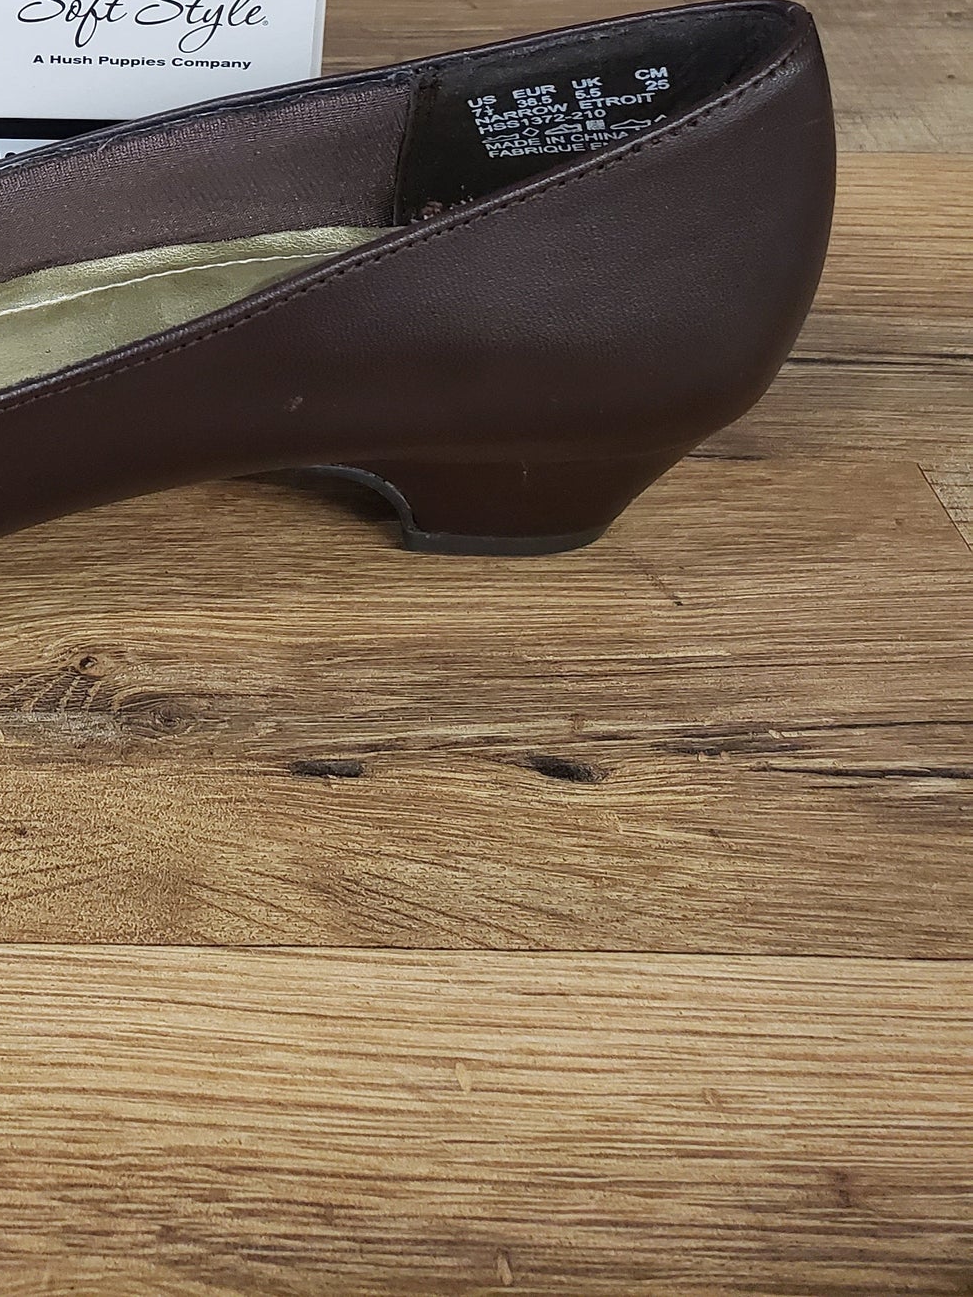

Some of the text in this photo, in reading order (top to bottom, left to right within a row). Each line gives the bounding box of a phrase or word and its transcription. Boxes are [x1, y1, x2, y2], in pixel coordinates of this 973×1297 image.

[32, 54, 252, 70] A Hush Puppies Company
[467, 66, 669, 108] US EUR UK CM
[516, 95, 553, 108] 38.5
[574, 88, 602, 100] 5.5
[644, 79, 671, 92] 25
[474, 92, 656, 126] NARROW ETROIT
[477, 109, 607, 135] HSS1372-210
[485, 131, 630, 151] MADE IN CHINA
[488, 143, 587, 159] FABRIQUE
